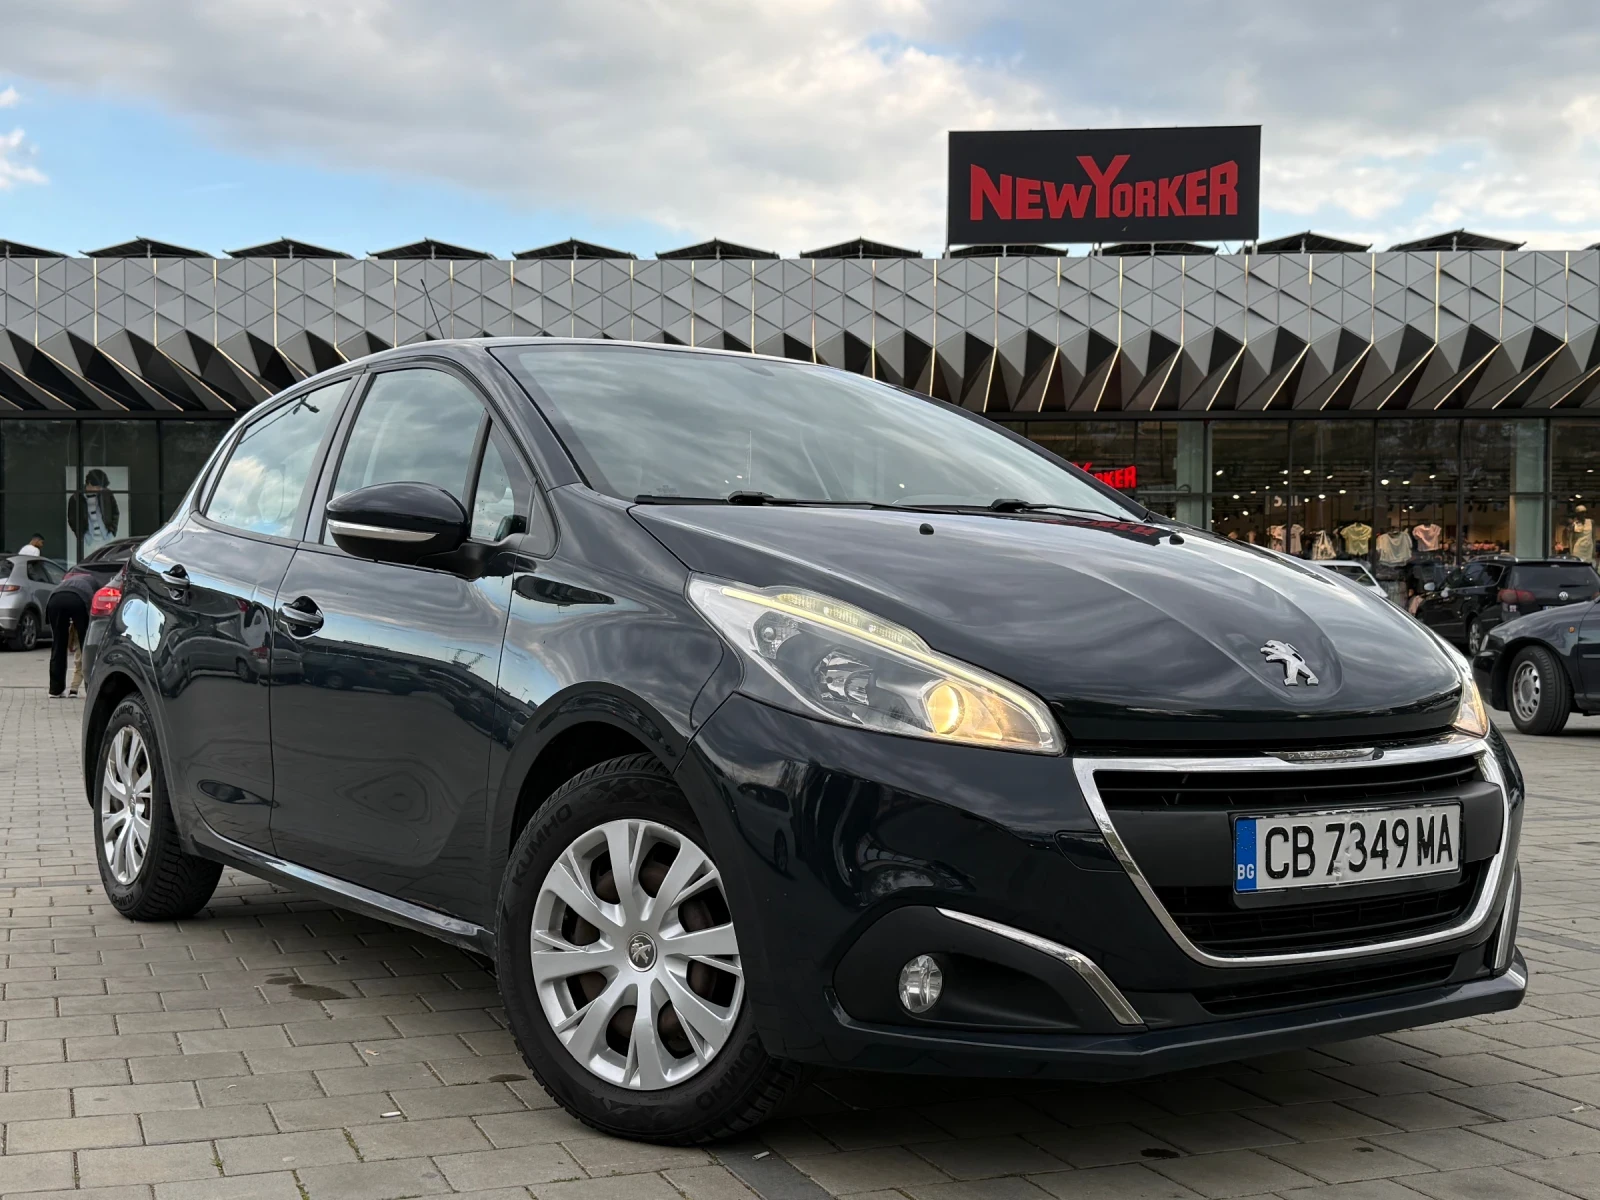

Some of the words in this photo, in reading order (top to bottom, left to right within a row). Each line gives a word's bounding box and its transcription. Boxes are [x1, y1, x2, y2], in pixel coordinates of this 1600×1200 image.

[512, 803, 572, 886] KUMHO
[1237, 863, 1255, 880] BG
[1265, 825, 1316, 879] CB
[1325, 818, 1410, 876] 7349
[1416, 813, 1453, 867] MA
